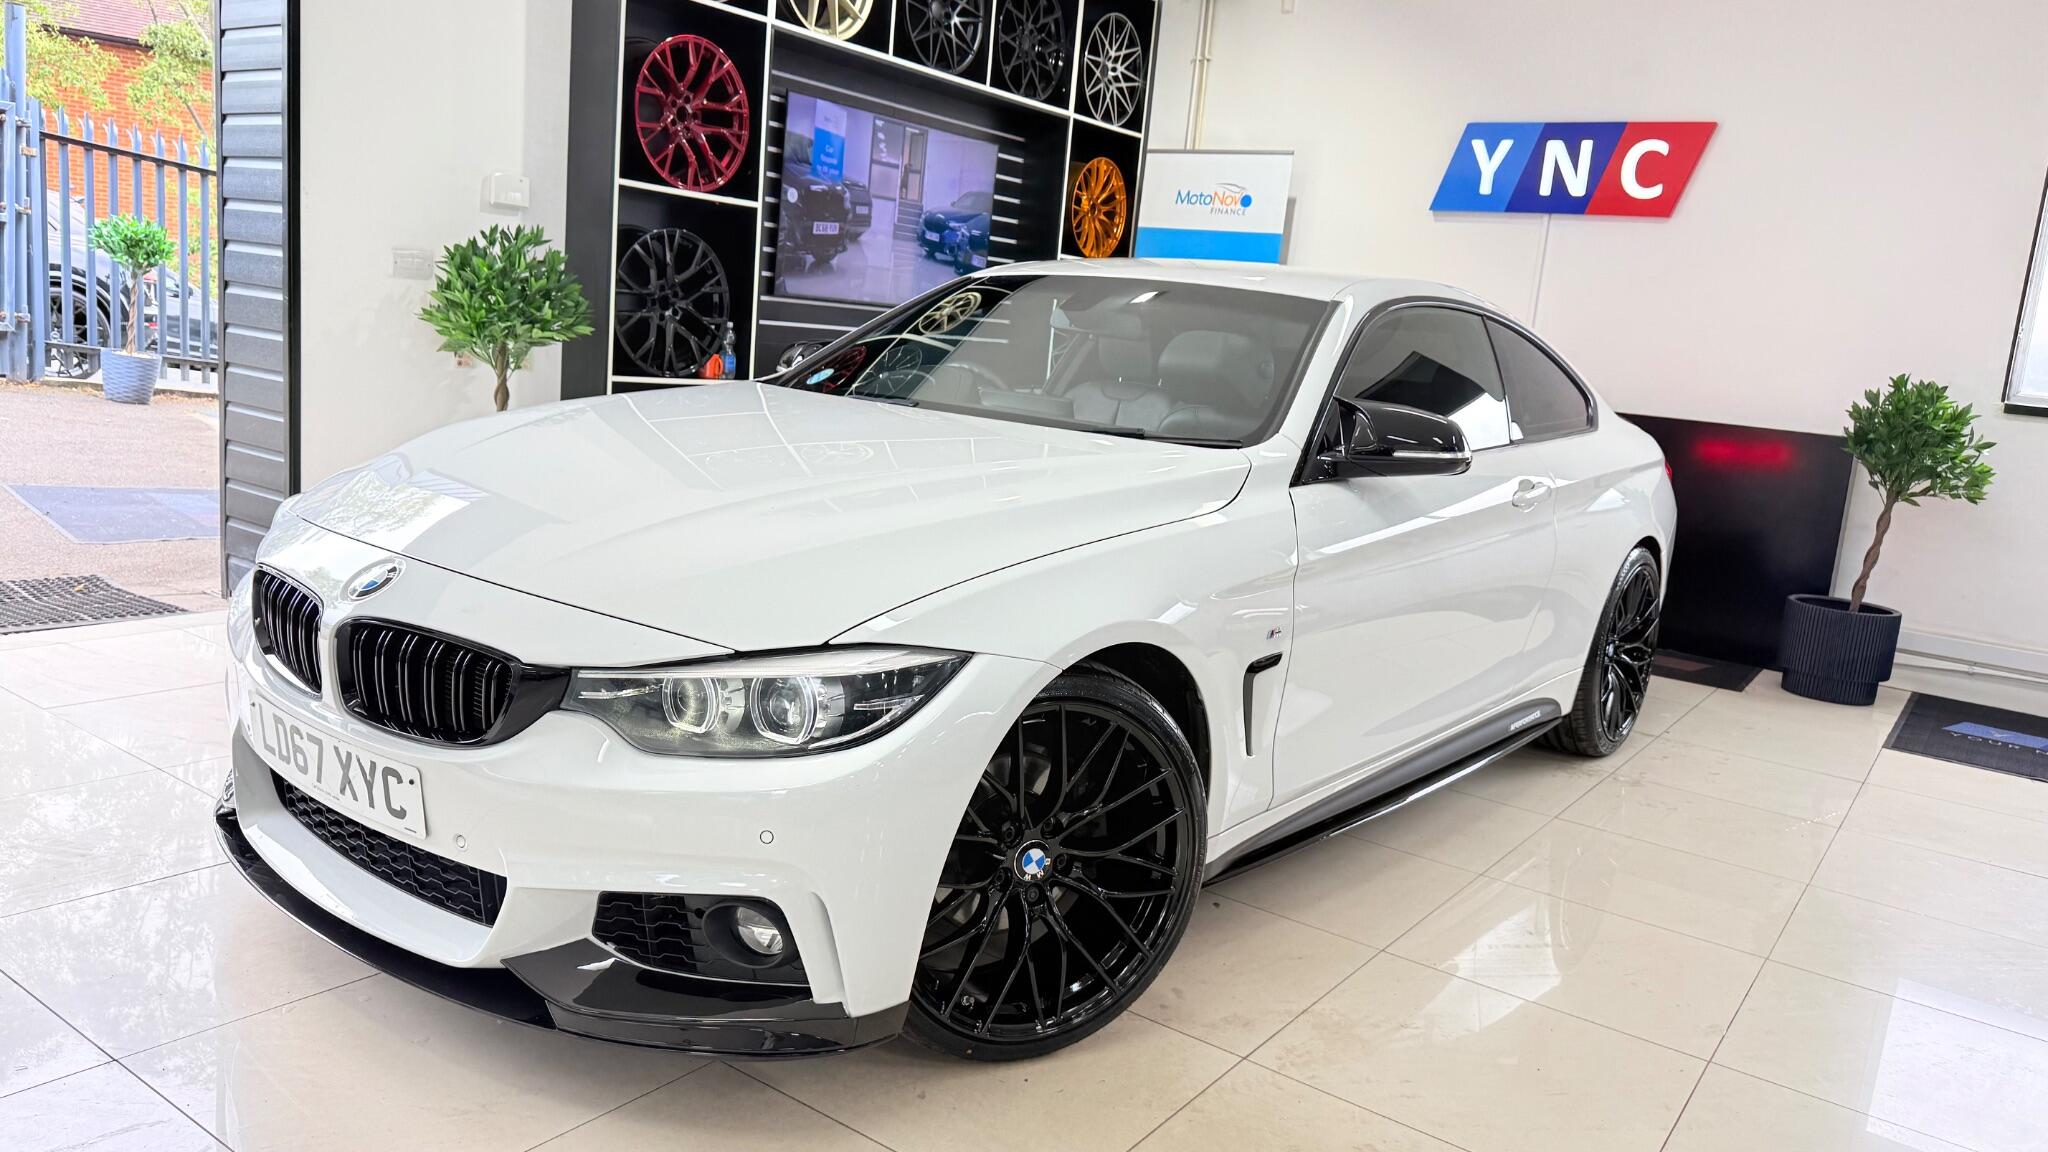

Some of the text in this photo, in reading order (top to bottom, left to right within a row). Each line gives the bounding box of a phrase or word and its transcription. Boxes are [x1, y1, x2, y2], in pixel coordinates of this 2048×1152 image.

[1471, 138, 1670, 200] YNC
[1210, 207, 1247, 216] FINANCE
[259, 703, 408, 820] LD67 XYC
